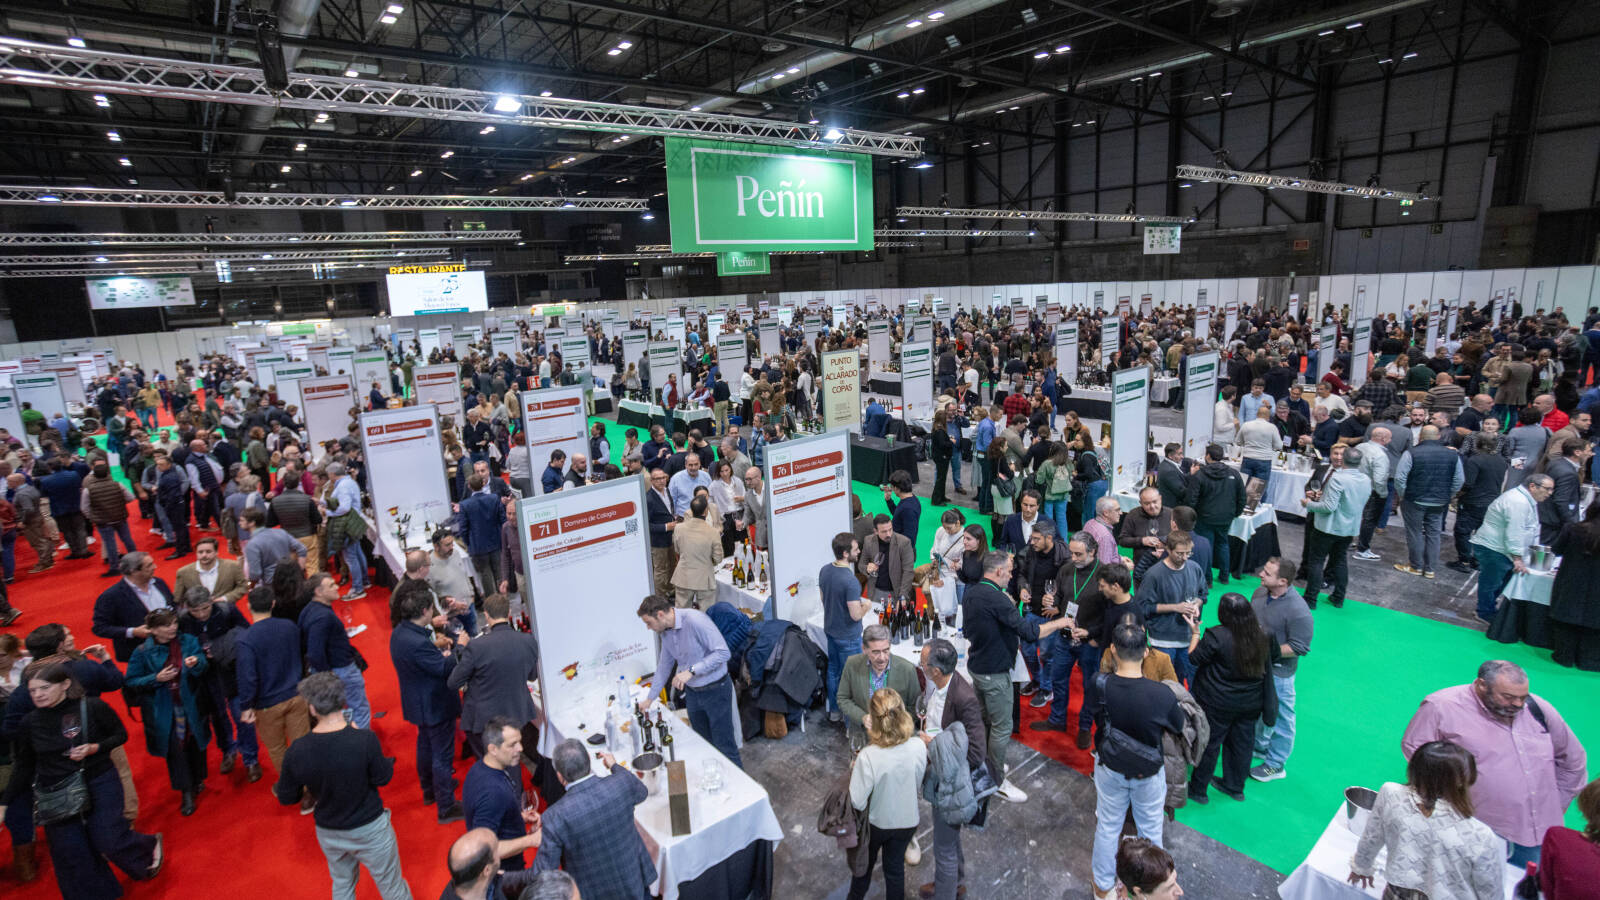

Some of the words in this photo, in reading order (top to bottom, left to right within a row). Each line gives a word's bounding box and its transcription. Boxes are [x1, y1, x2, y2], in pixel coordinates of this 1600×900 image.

[736, 175, 824, 218] Peñín
[732, 255, 756, 267] Peñín
[830, 356, 852, 366] PUNTO
[825, 370, 857, 380] ACLARADO
[832, 384, 853, 394] COPAS
[538, 524, 551, 536] 71
